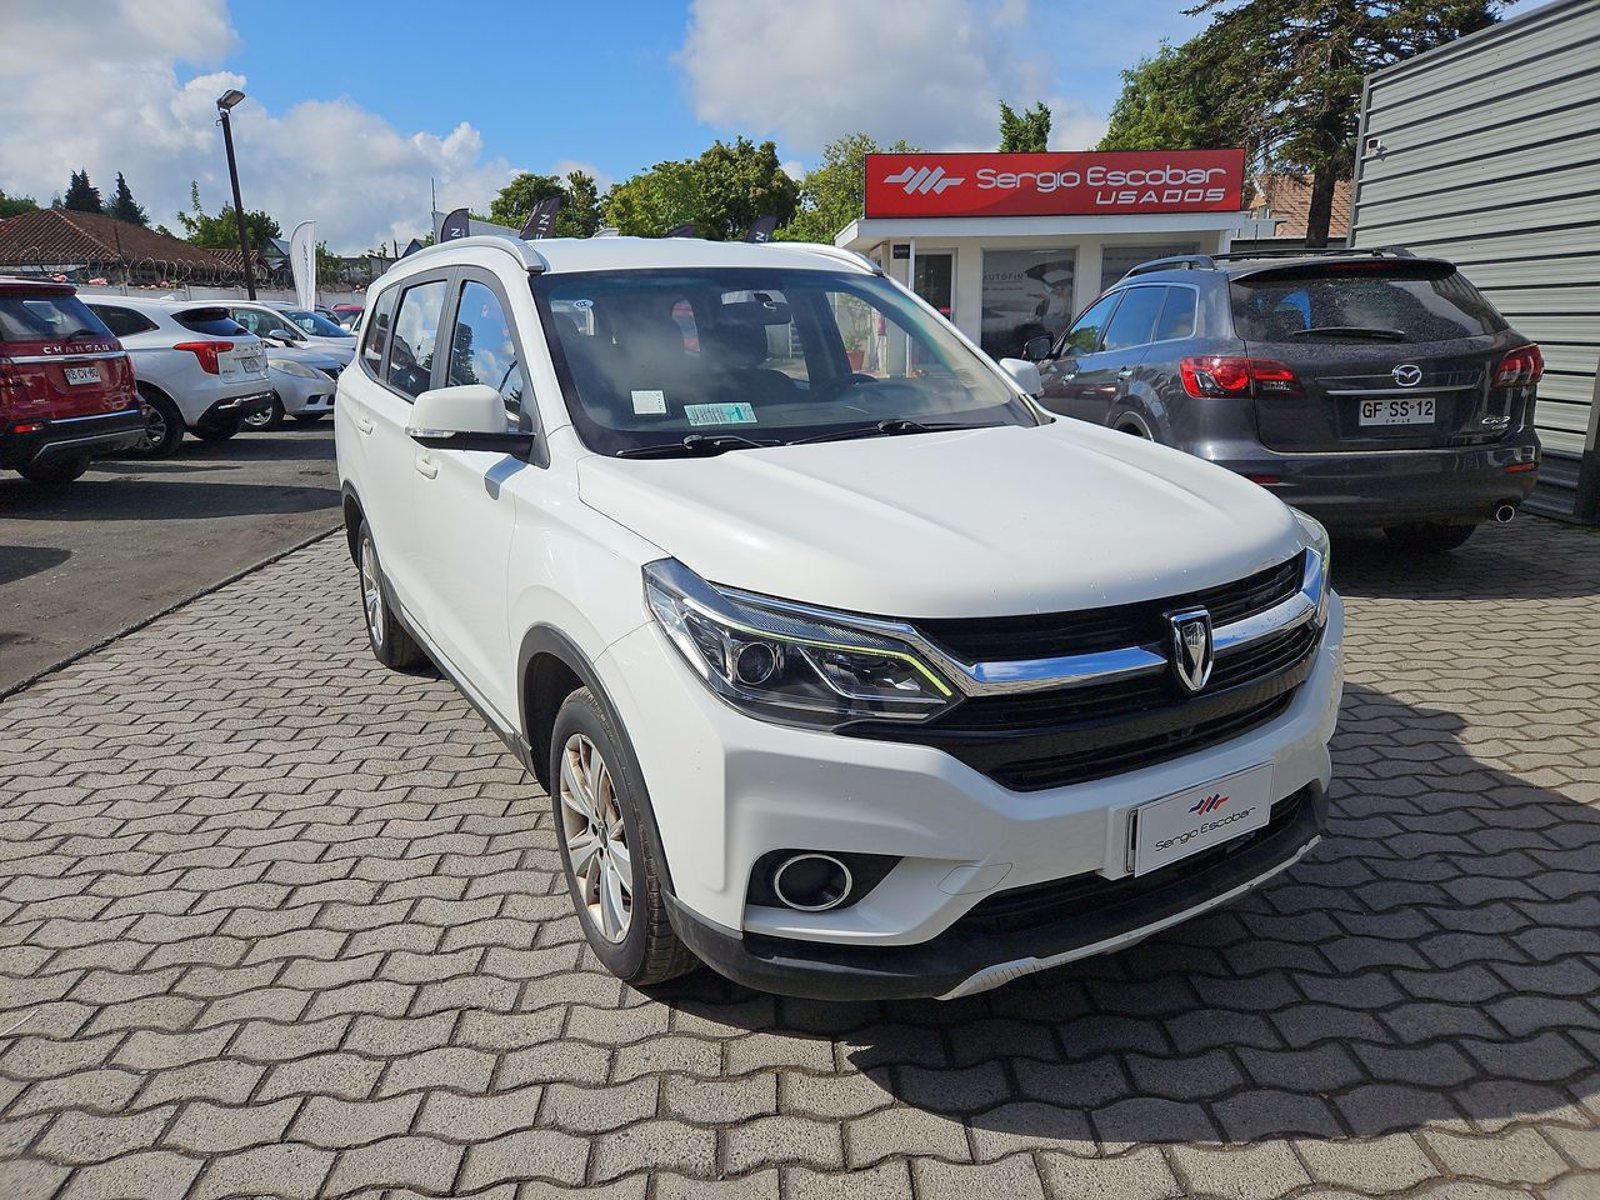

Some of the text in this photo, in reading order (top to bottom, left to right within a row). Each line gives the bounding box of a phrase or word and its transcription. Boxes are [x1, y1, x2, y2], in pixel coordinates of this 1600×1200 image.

[976, 165, 1227, 193] Sergio Escobar
[1096, 188, 1226, 205] USADOS
[1155, 807, 1256, 852] Sergio Escobar
